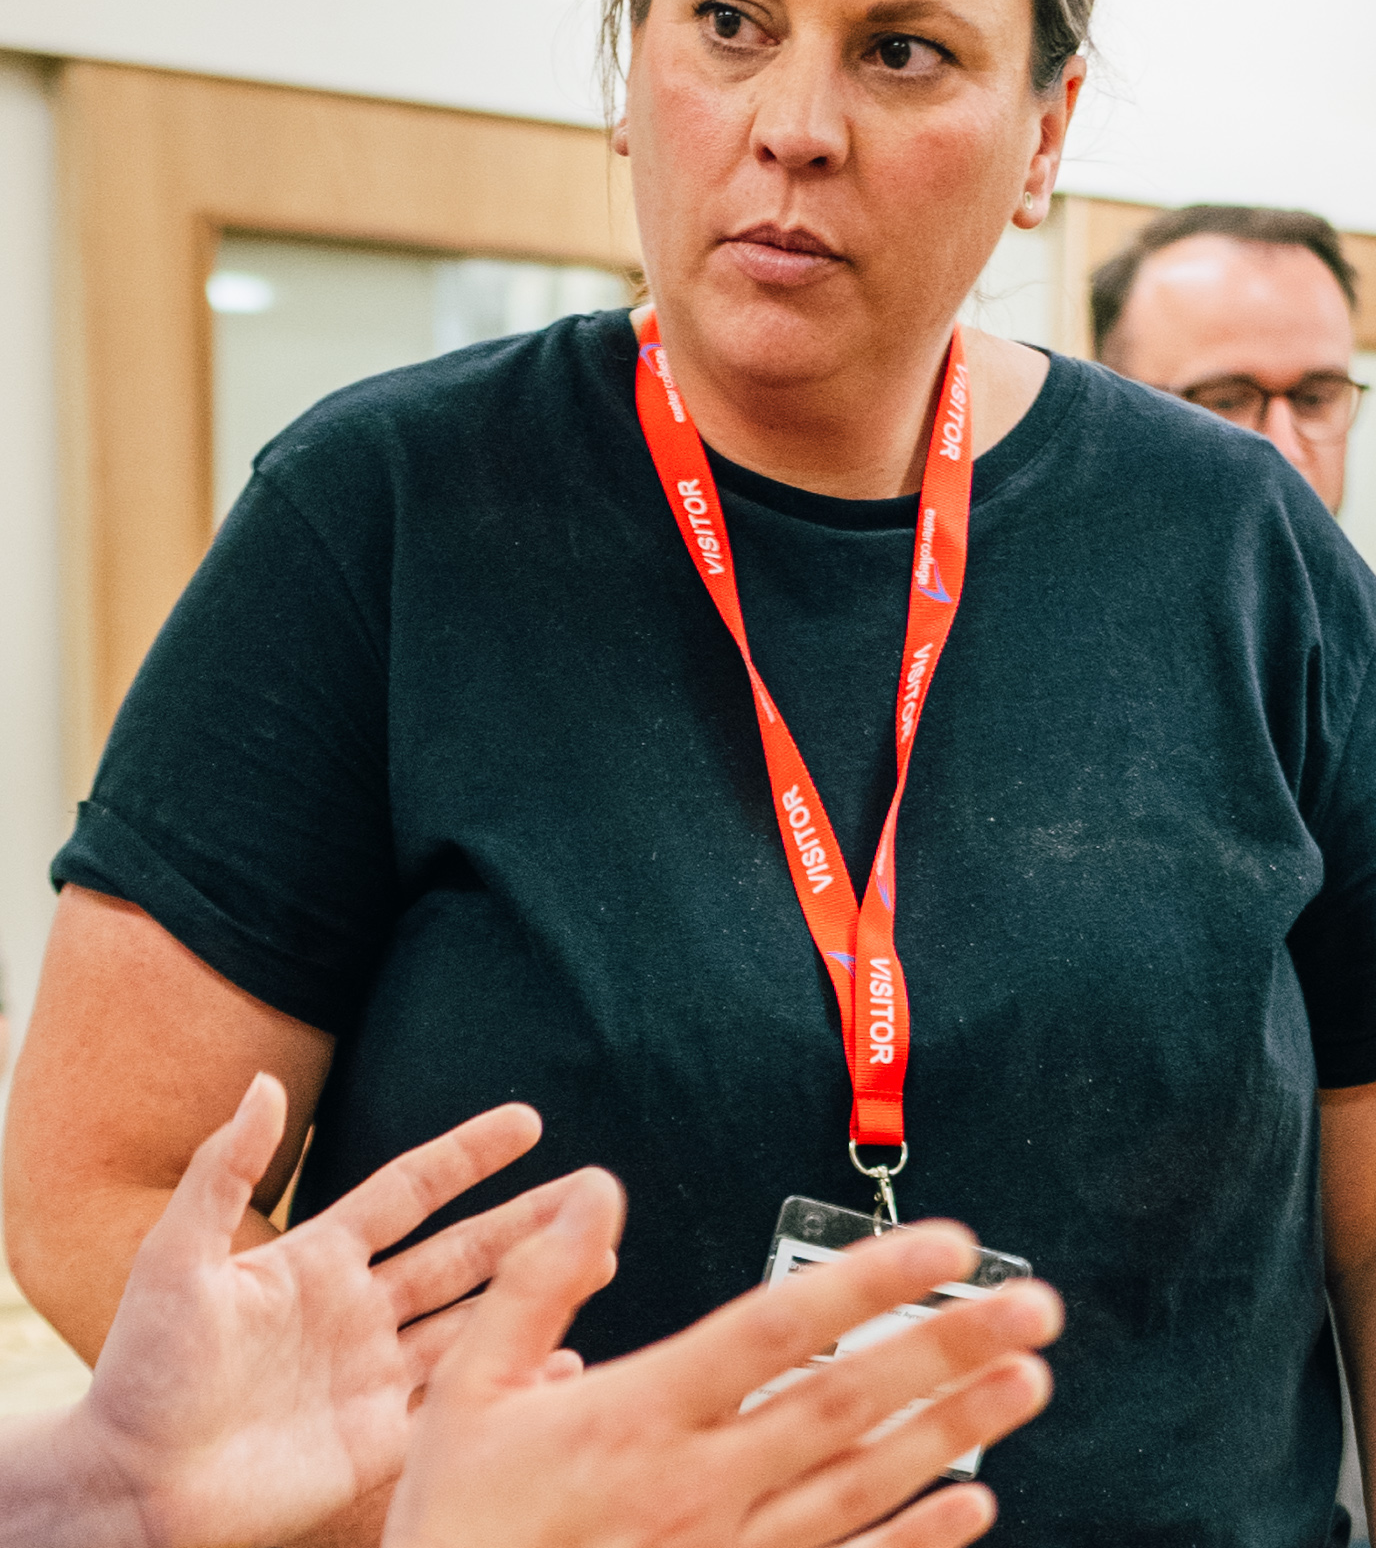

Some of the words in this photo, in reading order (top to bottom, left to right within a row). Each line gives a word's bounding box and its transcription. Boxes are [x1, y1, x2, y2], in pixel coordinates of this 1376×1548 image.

[939, 363, 968, 461] VISITOR
[677, 478, 725, 575] VISITOR
[901, 643, 933, 744] VISITOR
[782, 784, 834, 894] VISITOR
[868, 958, 895, 1065] VISITOR
